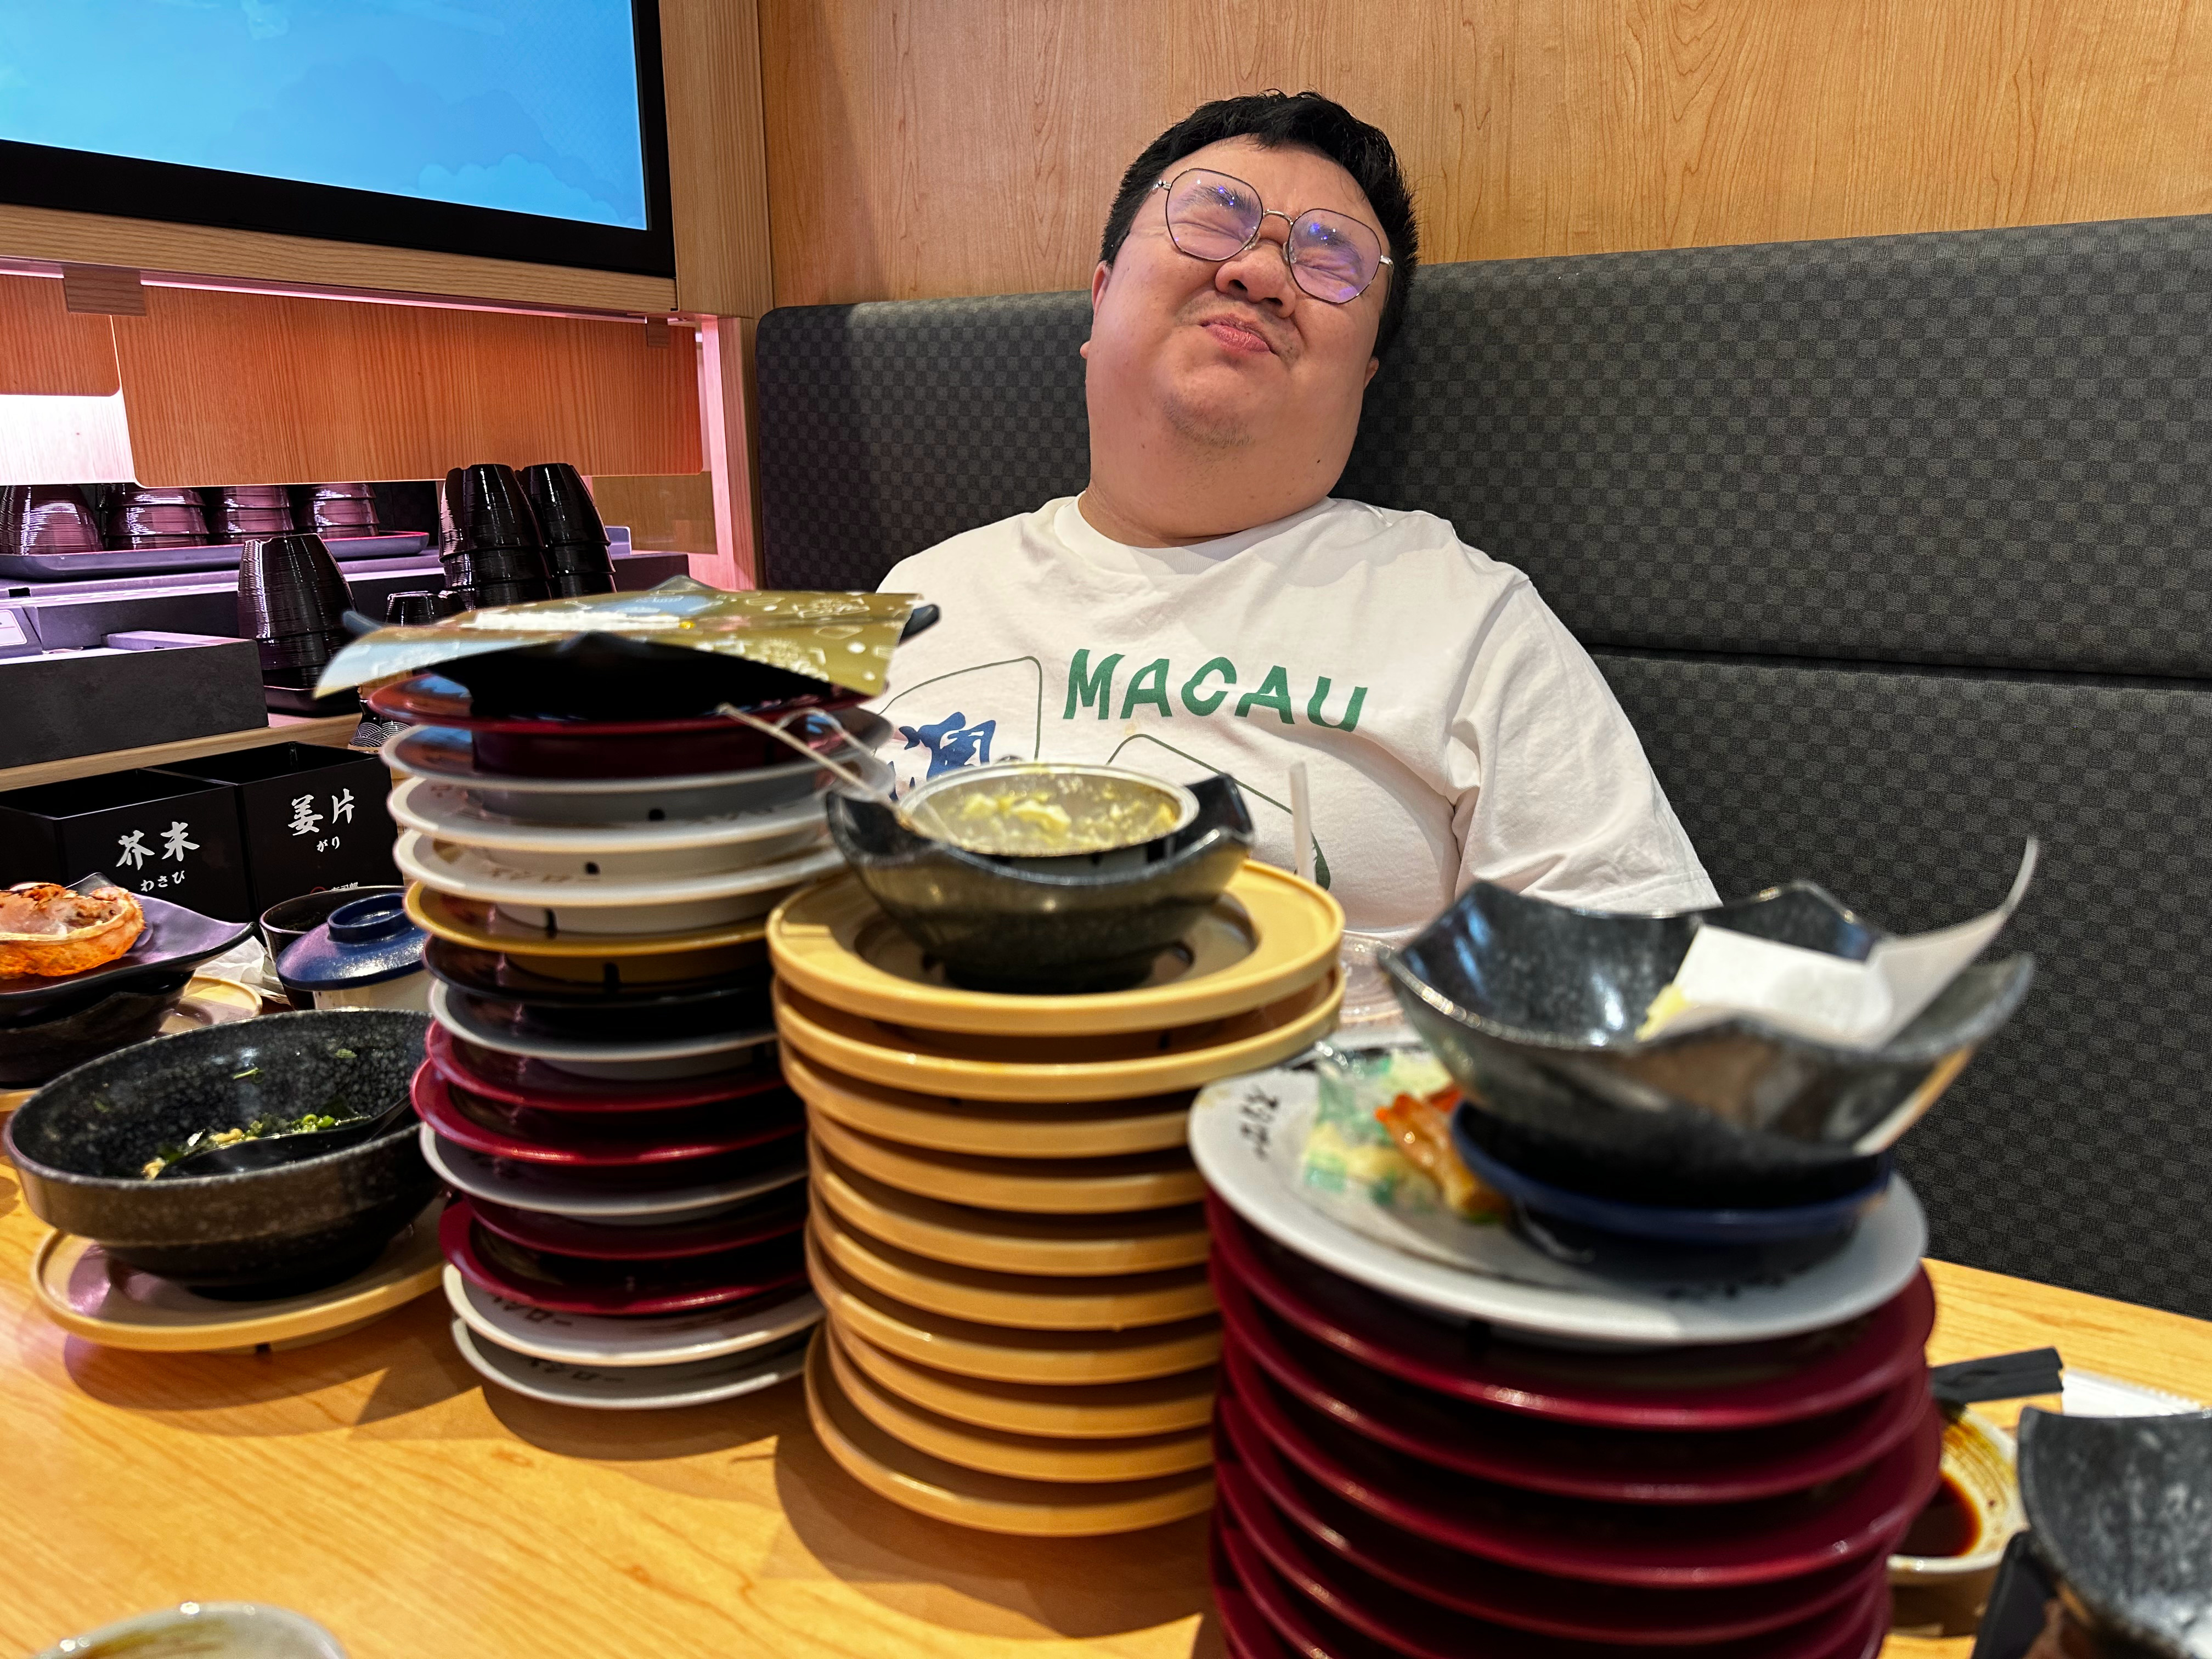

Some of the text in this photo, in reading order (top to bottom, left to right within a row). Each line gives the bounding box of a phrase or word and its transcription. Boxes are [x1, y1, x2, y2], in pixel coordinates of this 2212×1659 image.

[1063, 648, 1368, 732] MACAU
[287, 788, 355, 836] 姜片
[116, 821, 200, 871] 芥末
[316, 836, 340, 853] がり
